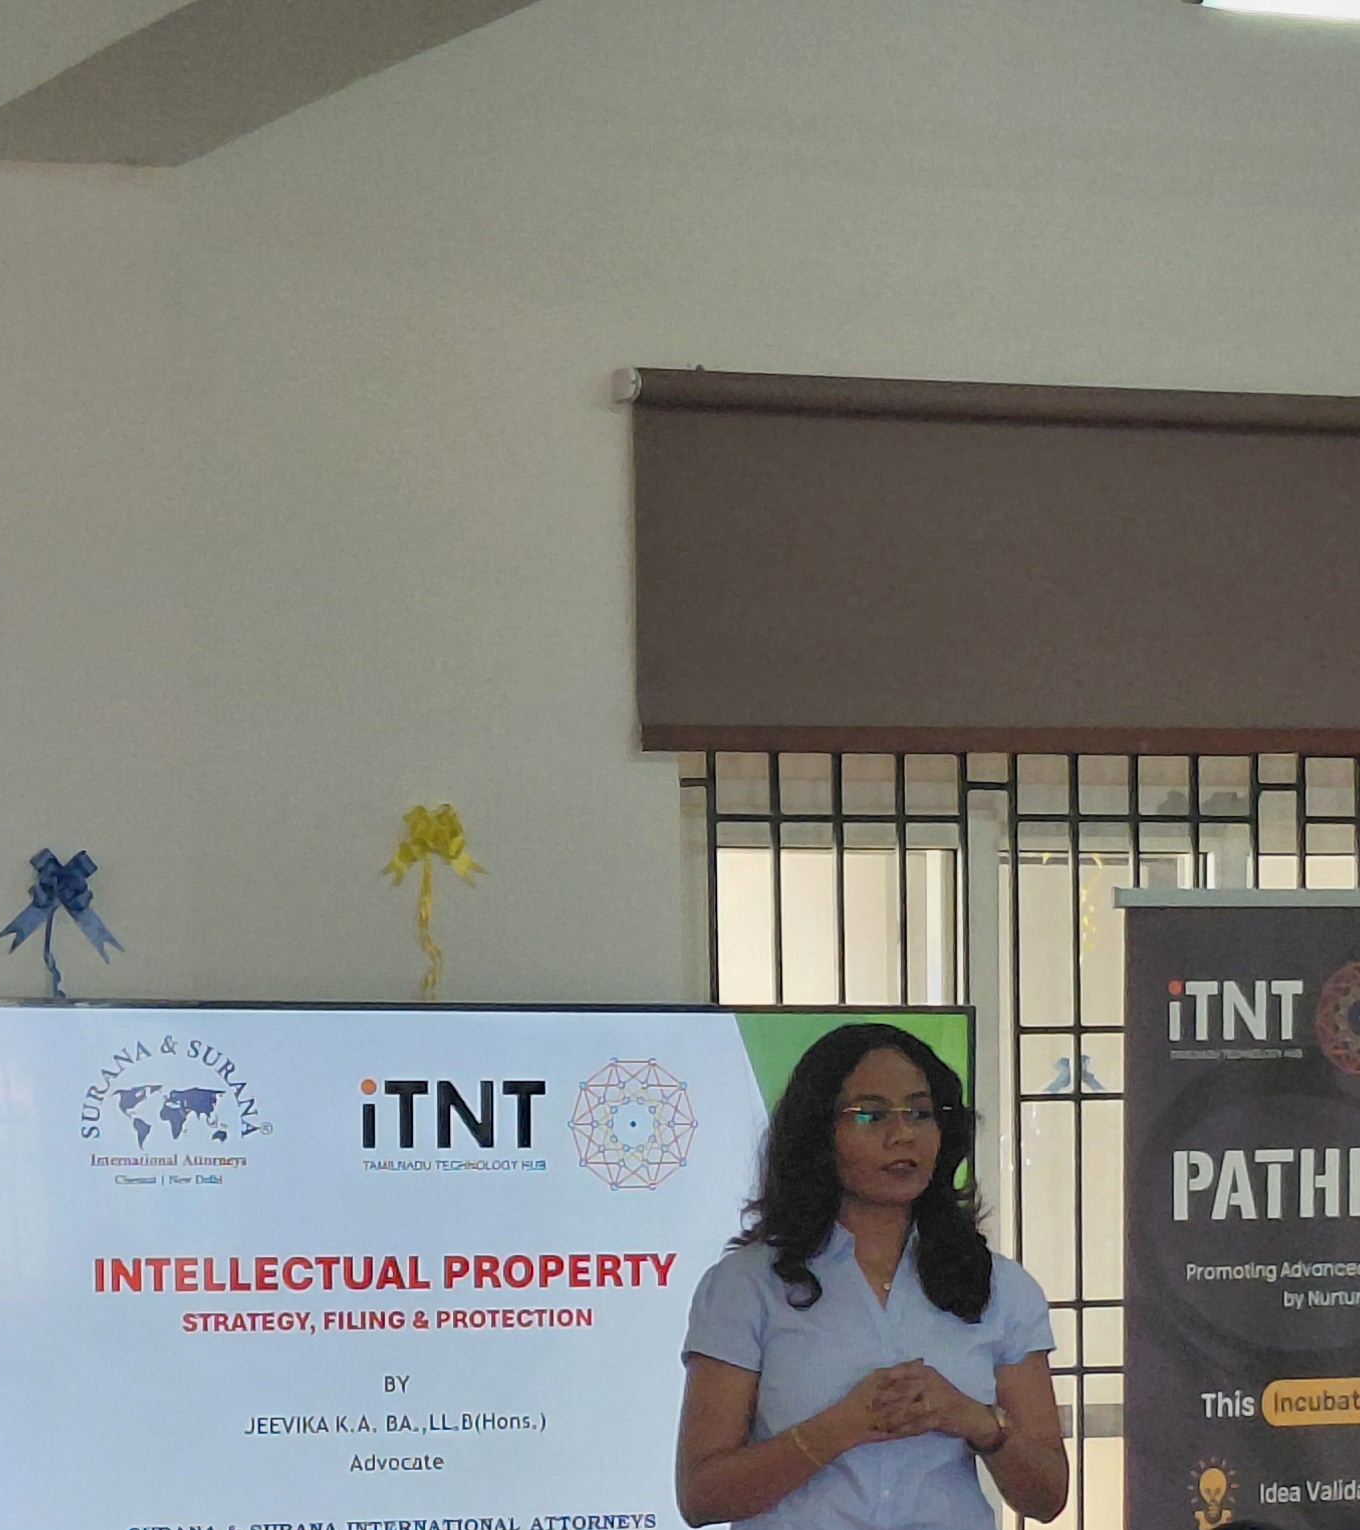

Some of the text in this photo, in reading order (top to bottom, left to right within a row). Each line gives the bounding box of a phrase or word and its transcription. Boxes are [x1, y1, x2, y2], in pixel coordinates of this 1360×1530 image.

[1168, 980, 1303, 1041] iTNT
[81, 1040, 153, 1139] SURANA
[159, 1035, 178, 1055] &
[187, 1039, 261, 1139] SURANA
[360, 1078, 546, 1148] iTNT
[90, 1154, 178, 1166] International
[94, 1253, 678, 1292] INTELLECTUAL PROPERTY
[1186, 1261, 1277, 1282] Promoting
[1283, 1290, 1304, 1309] by
[182, 1308, 593, 1335] STRATEGY, FILING & PROTECTION
[384, 1375, 410, 1393] BY
[1201, 1389, 1256, 1419] This
[244, 1416, 330, 1435] JEEVIKA
[350, 1454, 445, 1472] Advocate
[1259, 1482, 1301, 1505] Idea
